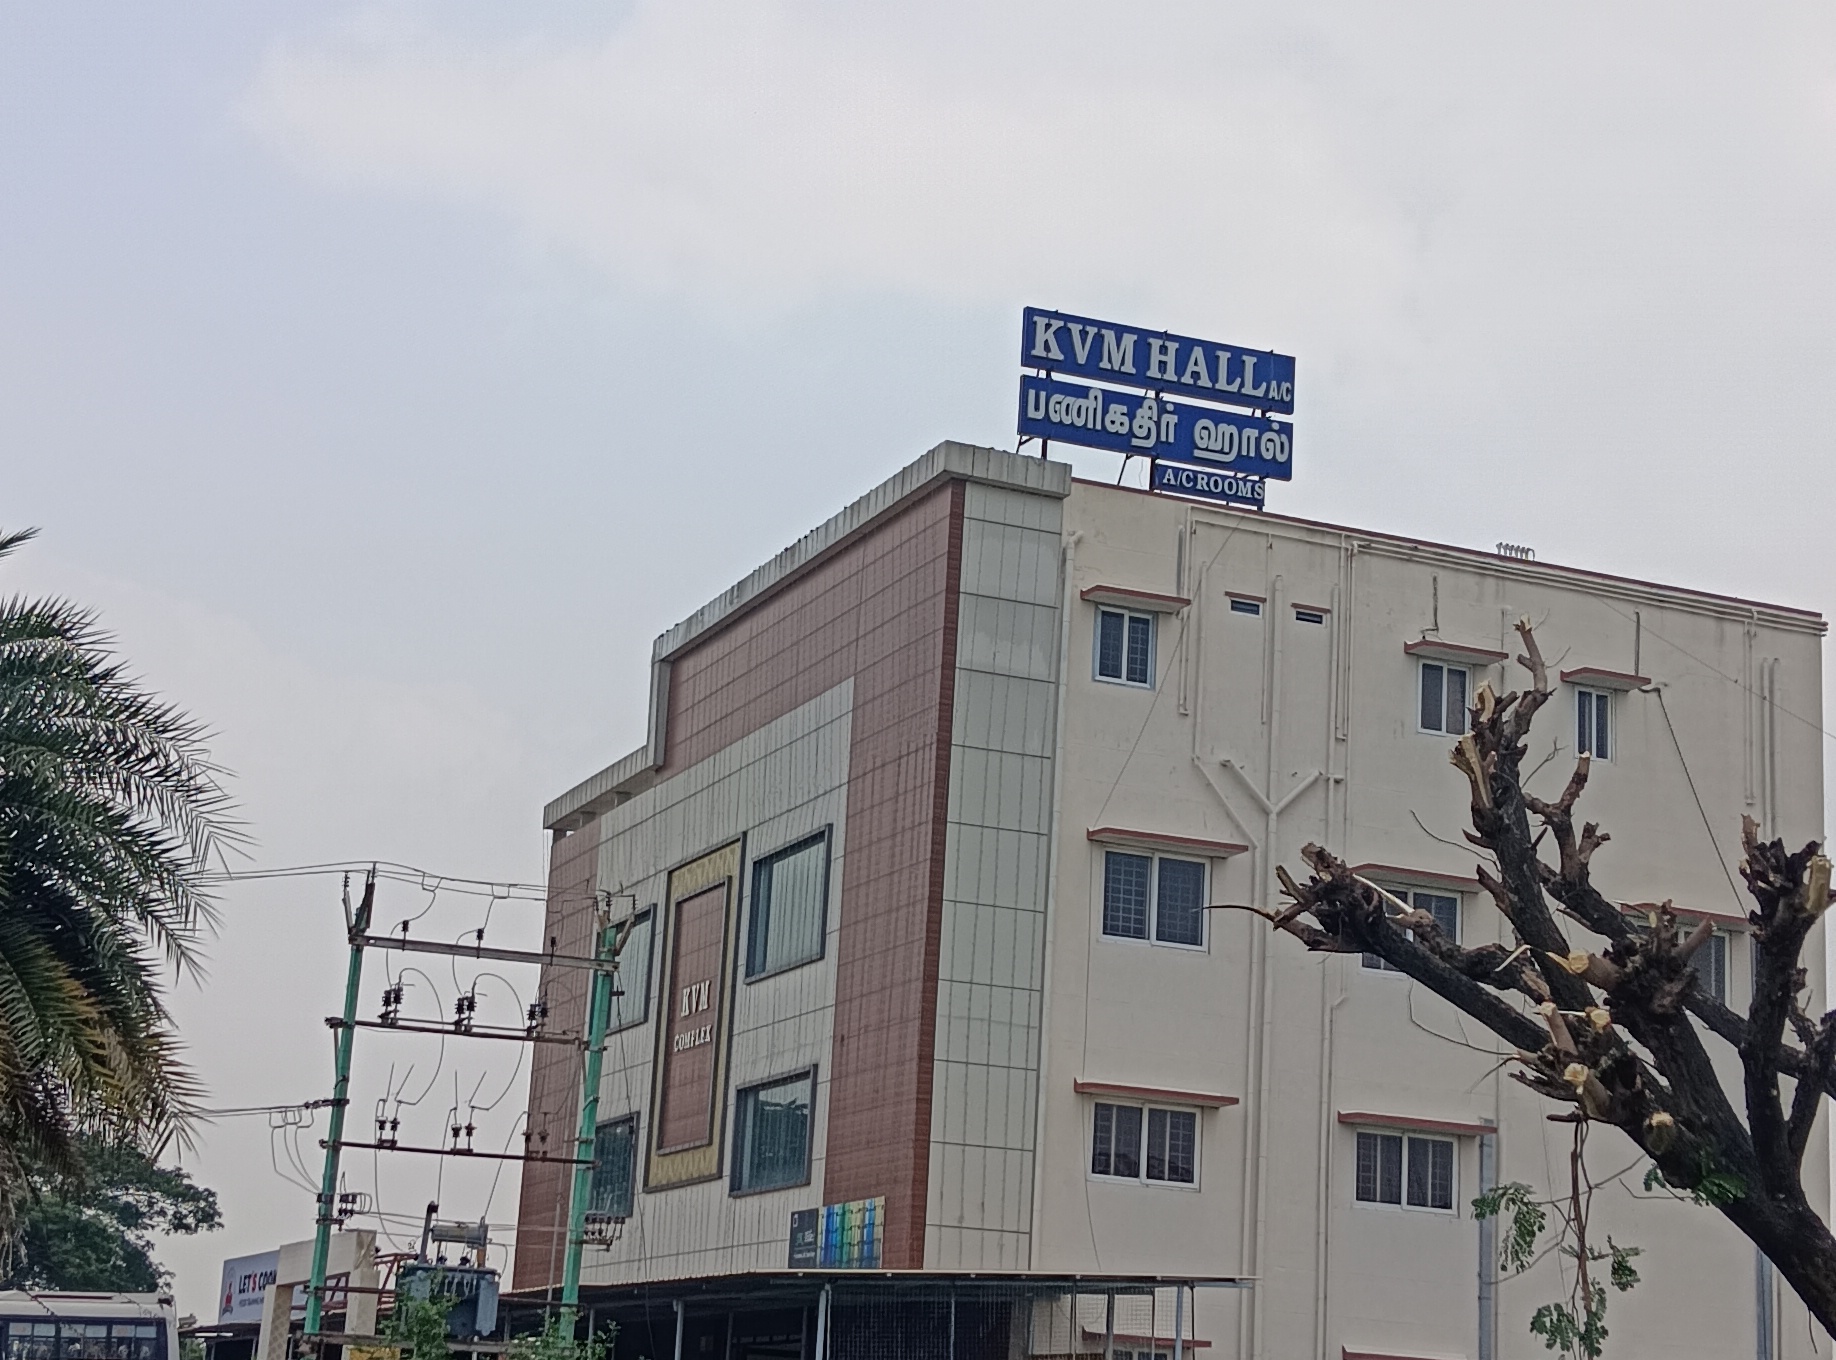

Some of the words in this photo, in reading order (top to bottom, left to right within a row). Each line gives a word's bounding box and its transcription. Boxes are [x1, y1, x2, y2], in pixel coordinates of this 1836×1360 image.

[1031, 316, 1137, 374] KVM
[1146, 338, 1267, 397] HALL
[1268, 380, 1292, 402] A/C
[1193, 419, 1290, 462] ஹால்
[1162, 468, 1193, 487] A/C
[1196, 474, 1264, 500] ROOMS
[681, 980, 710, 1017] KVM
